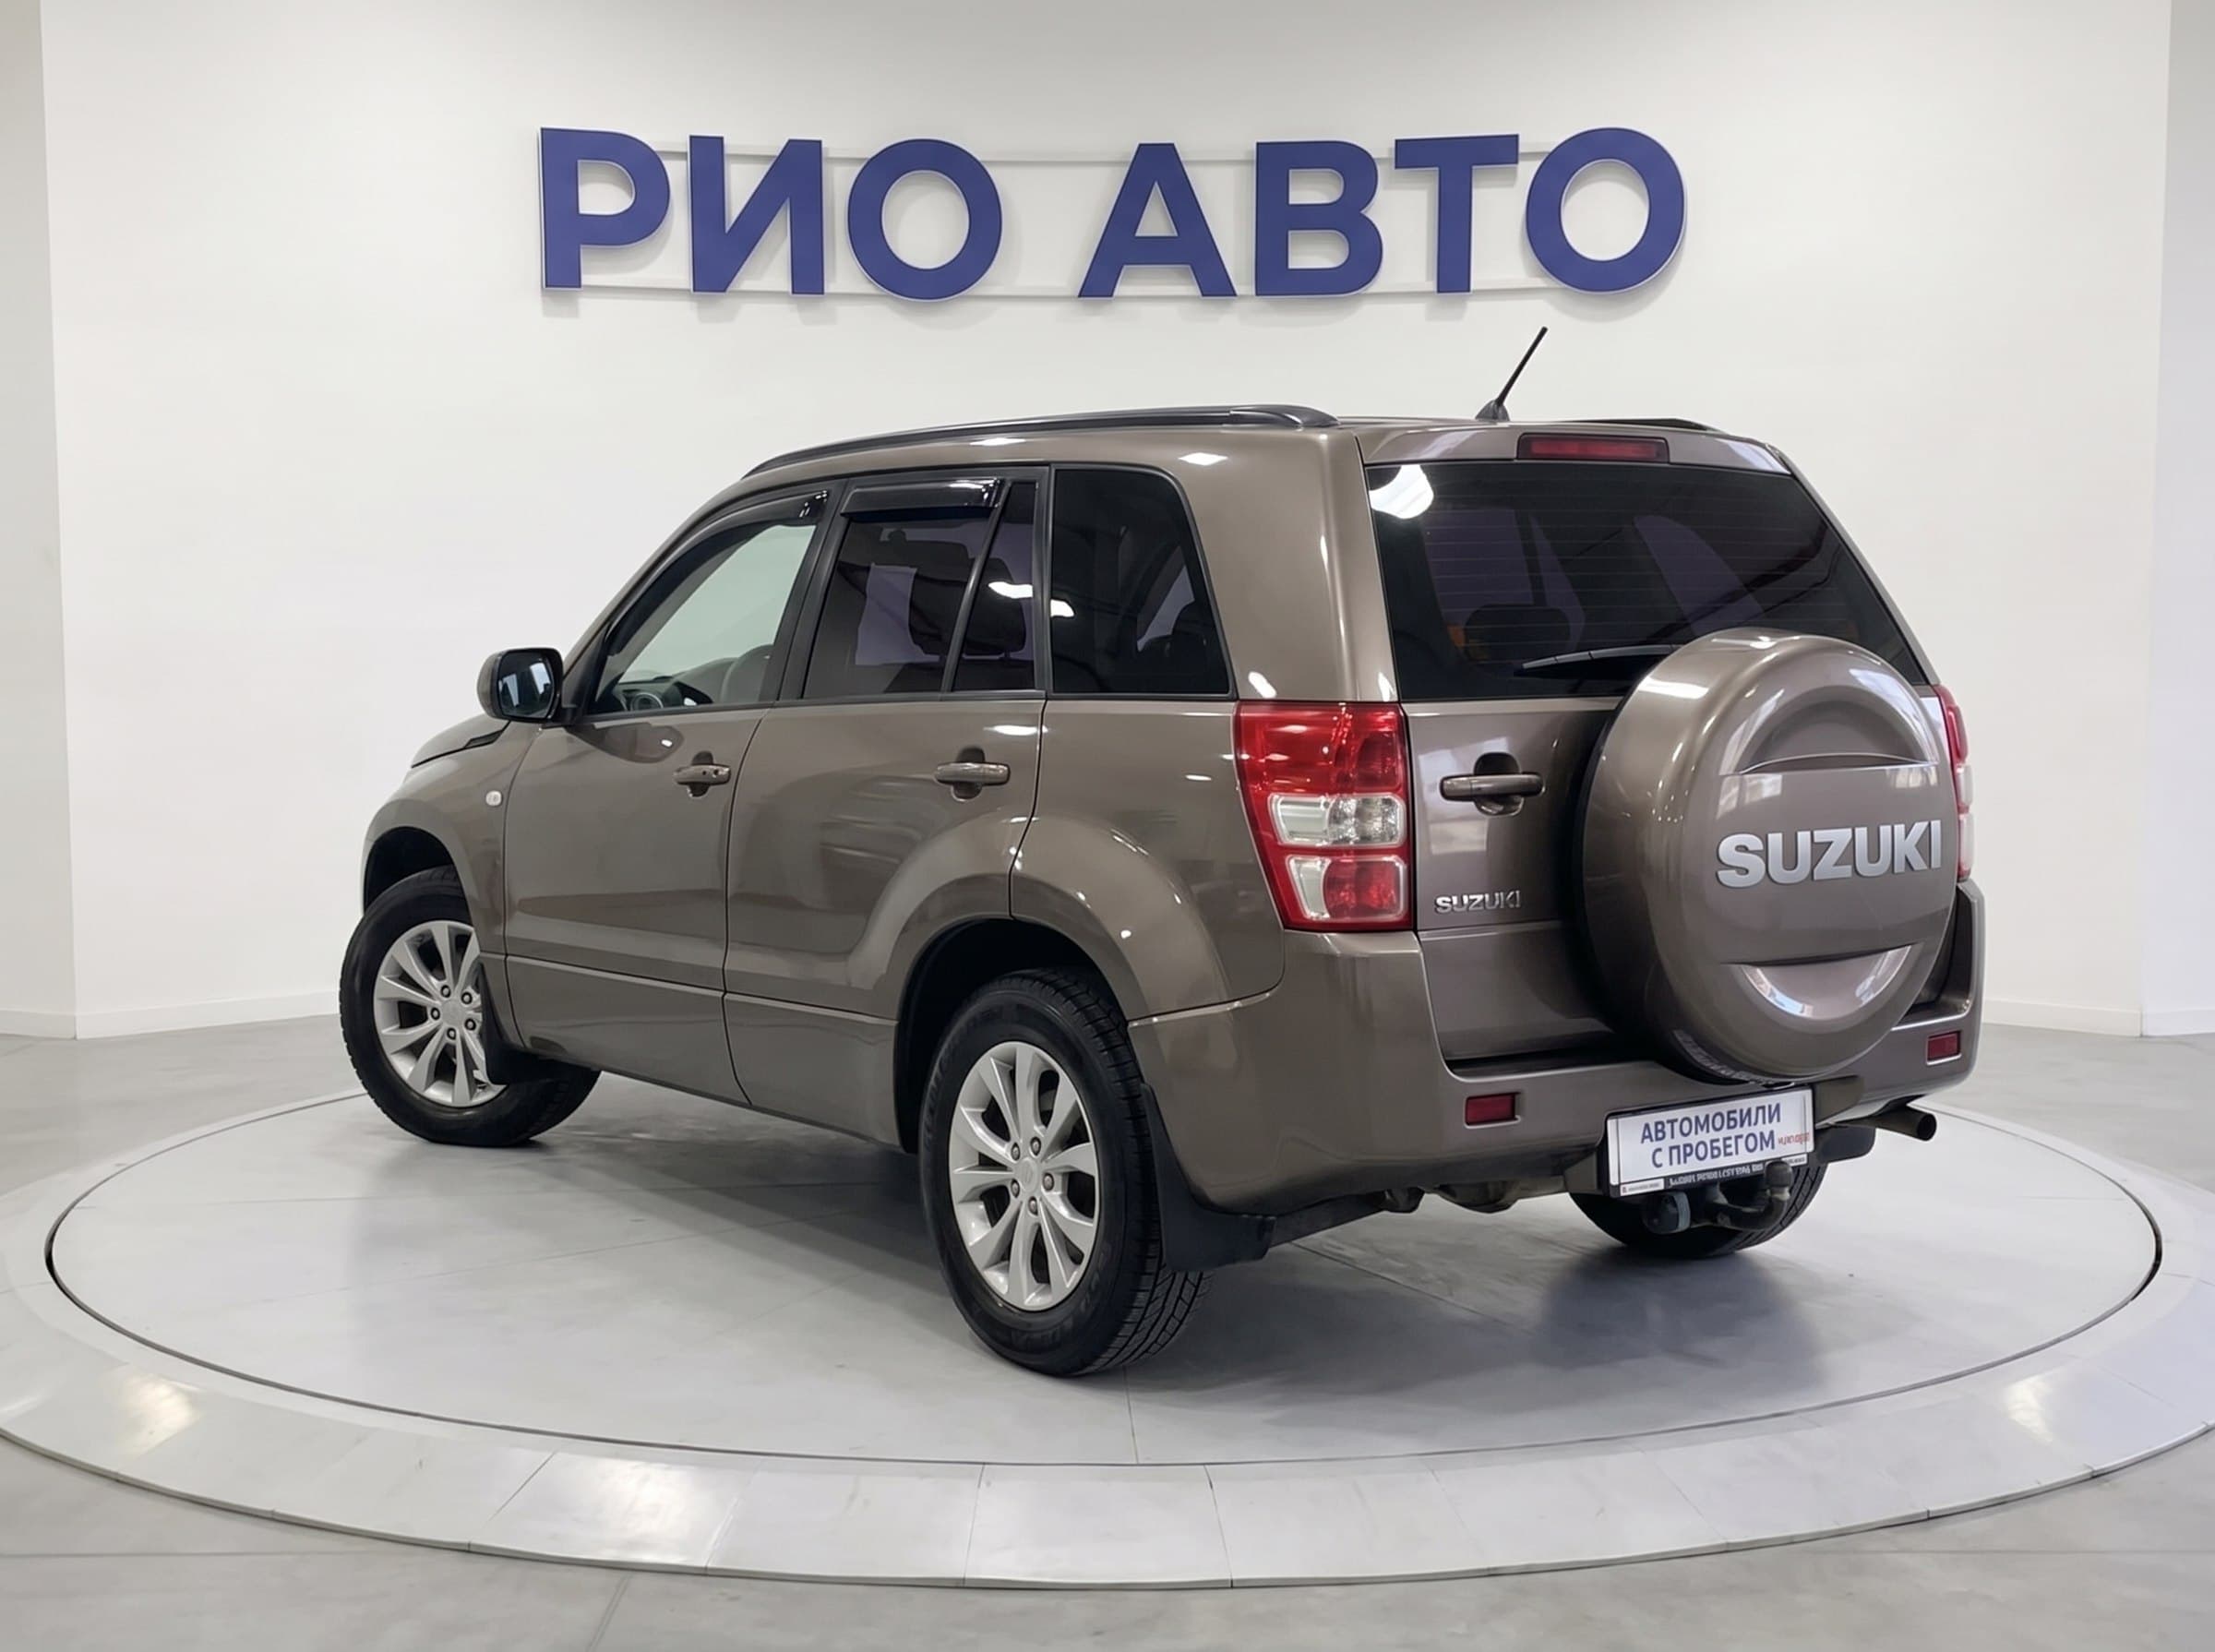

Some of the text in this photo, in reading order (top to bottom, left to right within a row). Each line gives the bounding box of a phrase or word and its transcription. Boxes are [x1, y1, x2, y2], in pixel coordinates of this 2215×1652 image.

[540, 127, 1687, 301] РИО АВТО
[1716, 819, 1942, 888] SUZUKI
[1434, 890, 1521, 914] SUZUKI
[1640, 1102, 1781, 1144] АВТОМОБИЛИ
[1651, 1147, 1663, 1168] С
[1669, 1130, 1775, 1167] ПРОБЕГОМ
